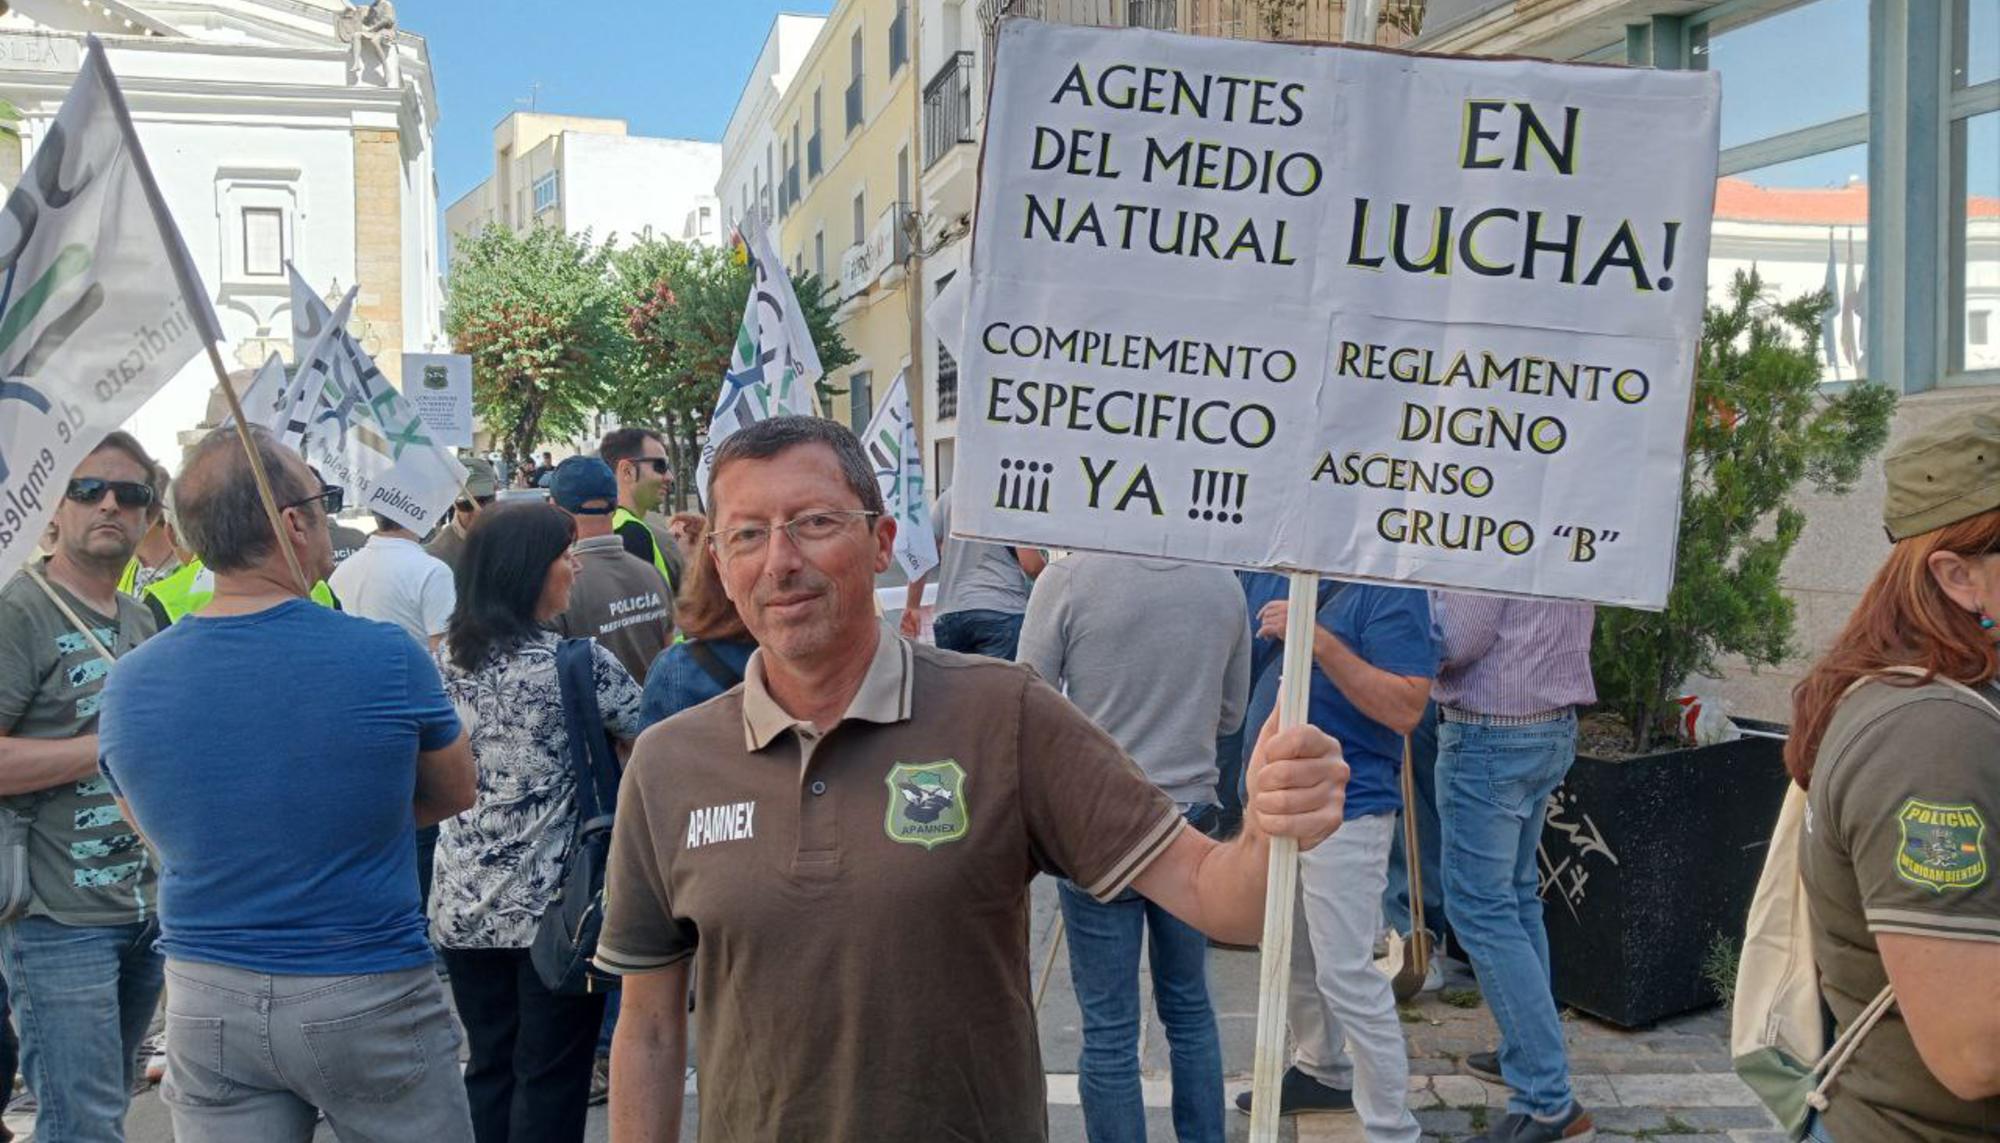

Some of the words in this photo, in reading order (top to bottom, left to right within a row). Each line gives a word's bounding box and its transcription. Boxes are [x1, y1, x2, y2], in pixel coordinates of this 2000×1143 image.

[1051, 62, 1305, 127] AGENTES
[1031, 126, 1121, 179] DEL
[1143, 136, 1323, 197] MEDIO
[1460, 100, 1580, 175] EN
[1024, 194, 1296, 266] NATURAL
[1347, 197, 1682, 292] LUCHA!
[982, 322, 1297, 383] COMPLEMENTO
[1338, 341, 1650, 404] REGLAMENTO
[987, 377, 1276, 448] ESPECIFICO
[1400, 401, 1567, 455] DIGNO
[370, 486, 428, 521] públicos
[1079, 456, 1164, 515] YA
[1311, 451, 1494, 498] ASCENSO
[1377, 507, 1535, 556] GRUPO
[686, 801, 755, 849] APAMNEX
[901, 822, 956, 835] APAMNEX
[1906, 808, 1977, 827] POLICÍA
